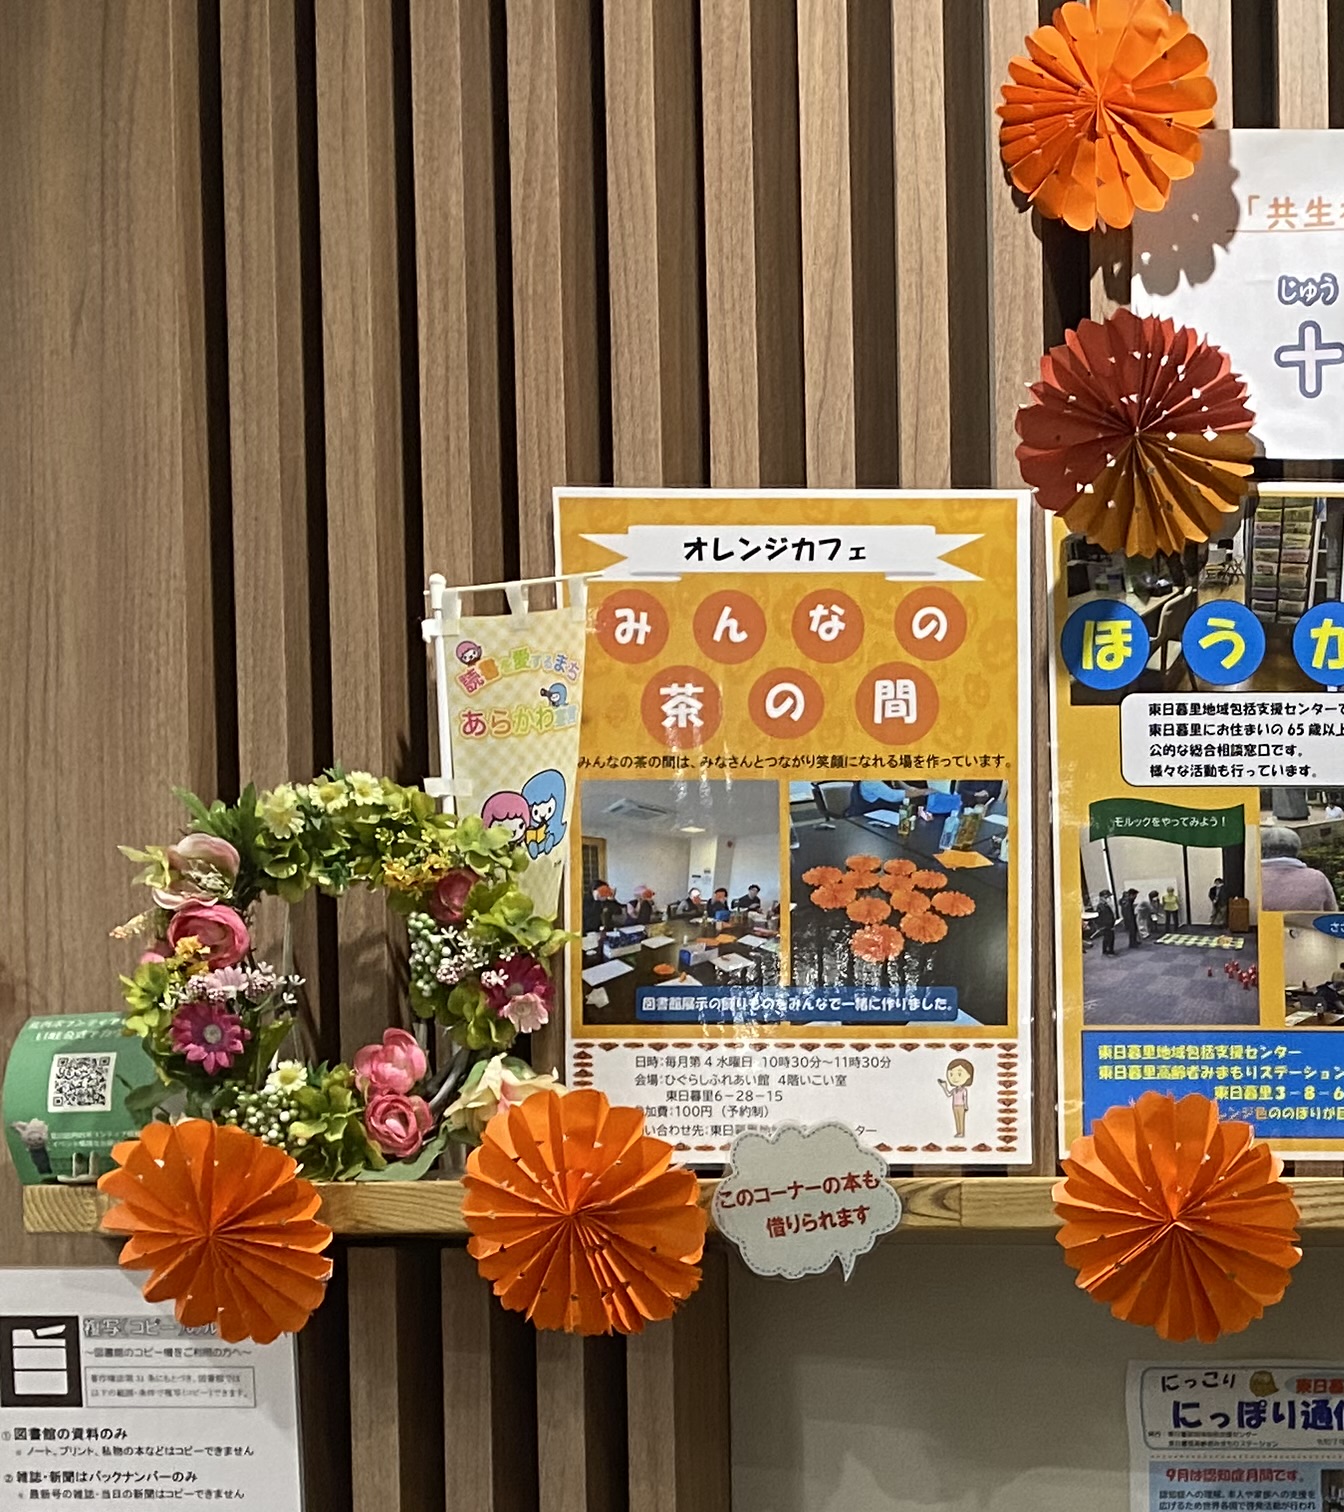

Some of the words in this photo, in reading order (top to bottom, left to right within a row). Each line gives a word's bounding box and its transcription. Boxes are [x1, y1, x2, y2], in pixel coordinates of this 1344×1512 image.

[1275, 275, 1339, 308] じゅう
[683, 537, 867, 562] オレンジカフェ
[613, 605, 948, 645] みんなの
[659, 679, 918, 728] 茶の間
[1149, 742, 1303, 757] 公的な総合相談窓口です。
[1149, 763, 1317, 778] 様々な活動も行っています。
[720, 1170, 880, 1209] このコーナーの本も
[766, 1204, 870, 1239] 借りられます
[1162, 1371, 1236, 1392] にっこり
[14, 1427, 127, 1441] 図書館の資料のみ
[17, 1470, 198, 1483] 雑誌・新聞はバックナンバーのみ
